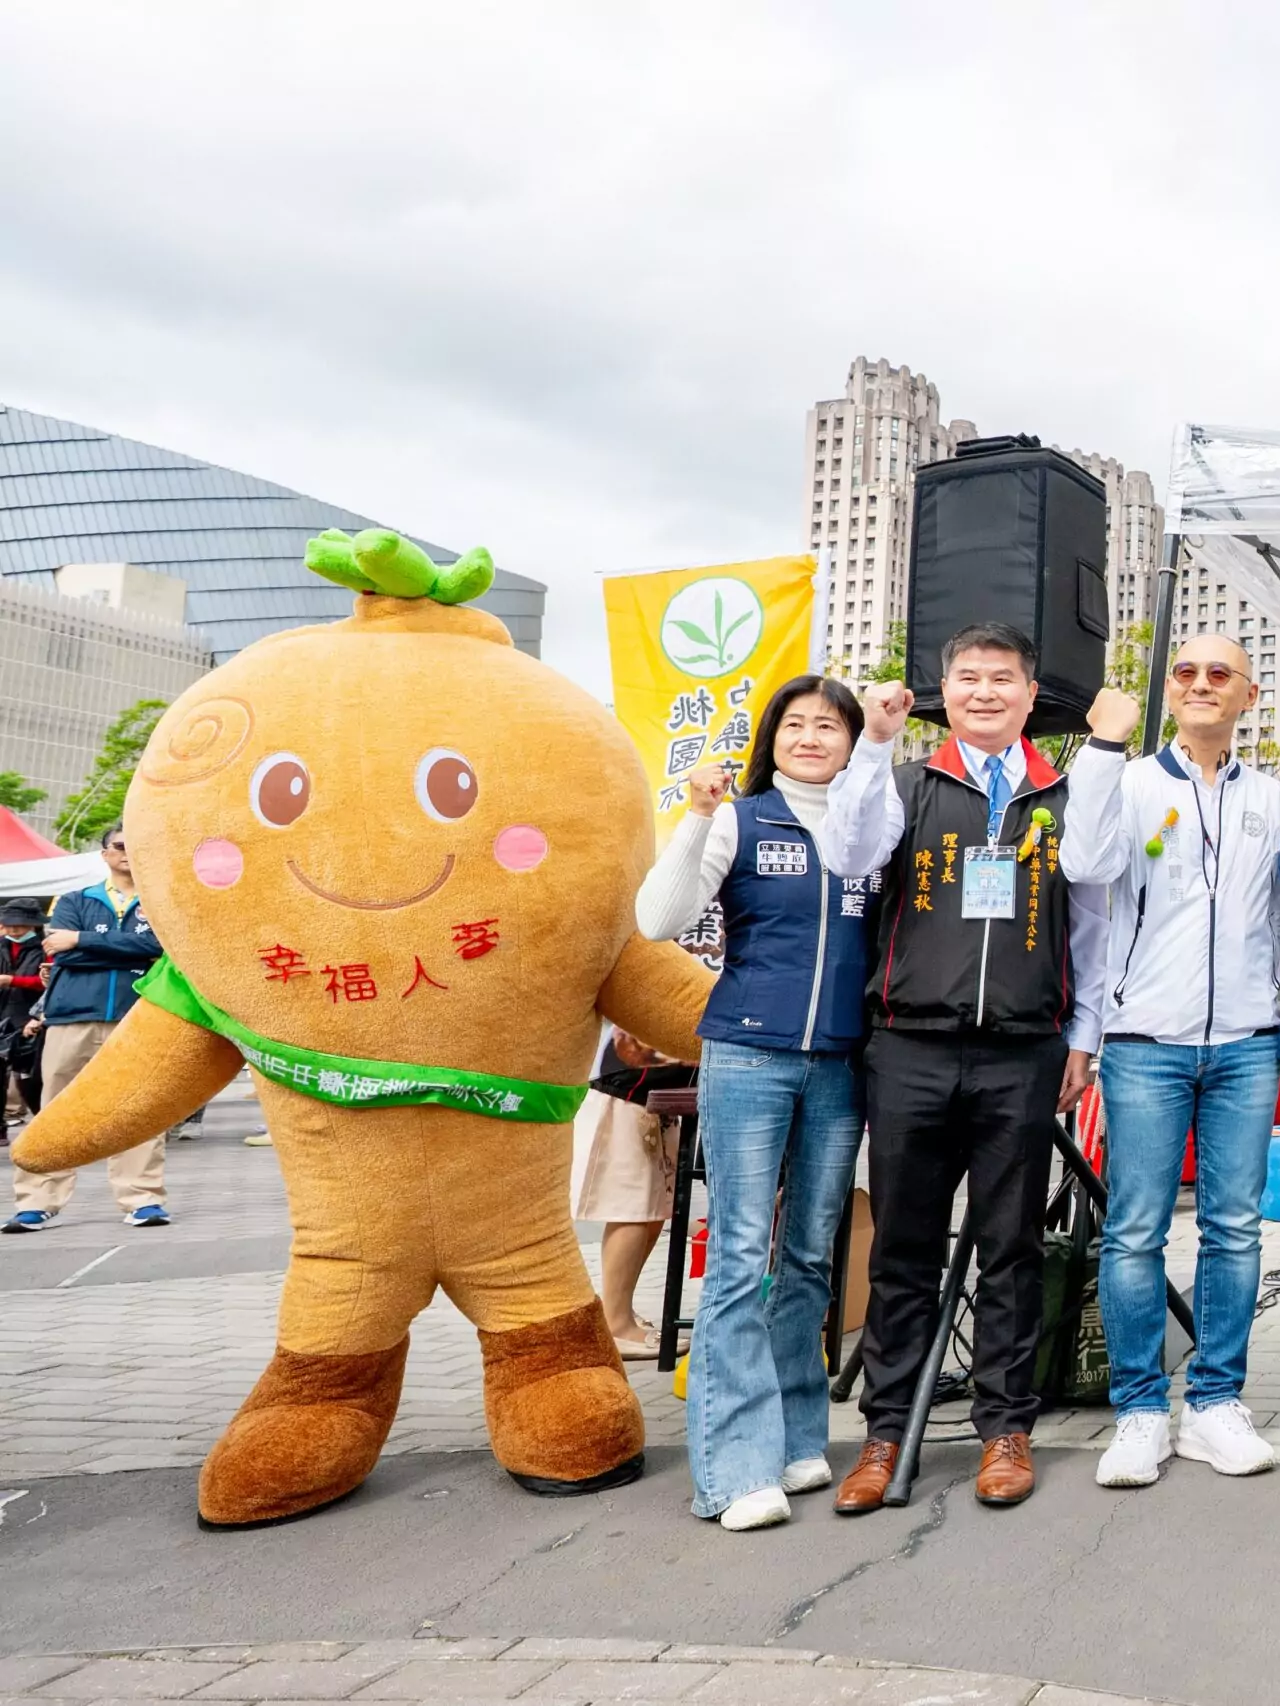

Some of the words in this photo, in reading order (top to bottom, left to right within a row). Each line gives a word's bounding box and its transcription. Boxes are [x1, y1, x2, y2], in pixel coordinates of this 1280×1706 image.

[941, 833, 958, 883] 理事長
[1046, 836, 1059, 873] 桃園市
